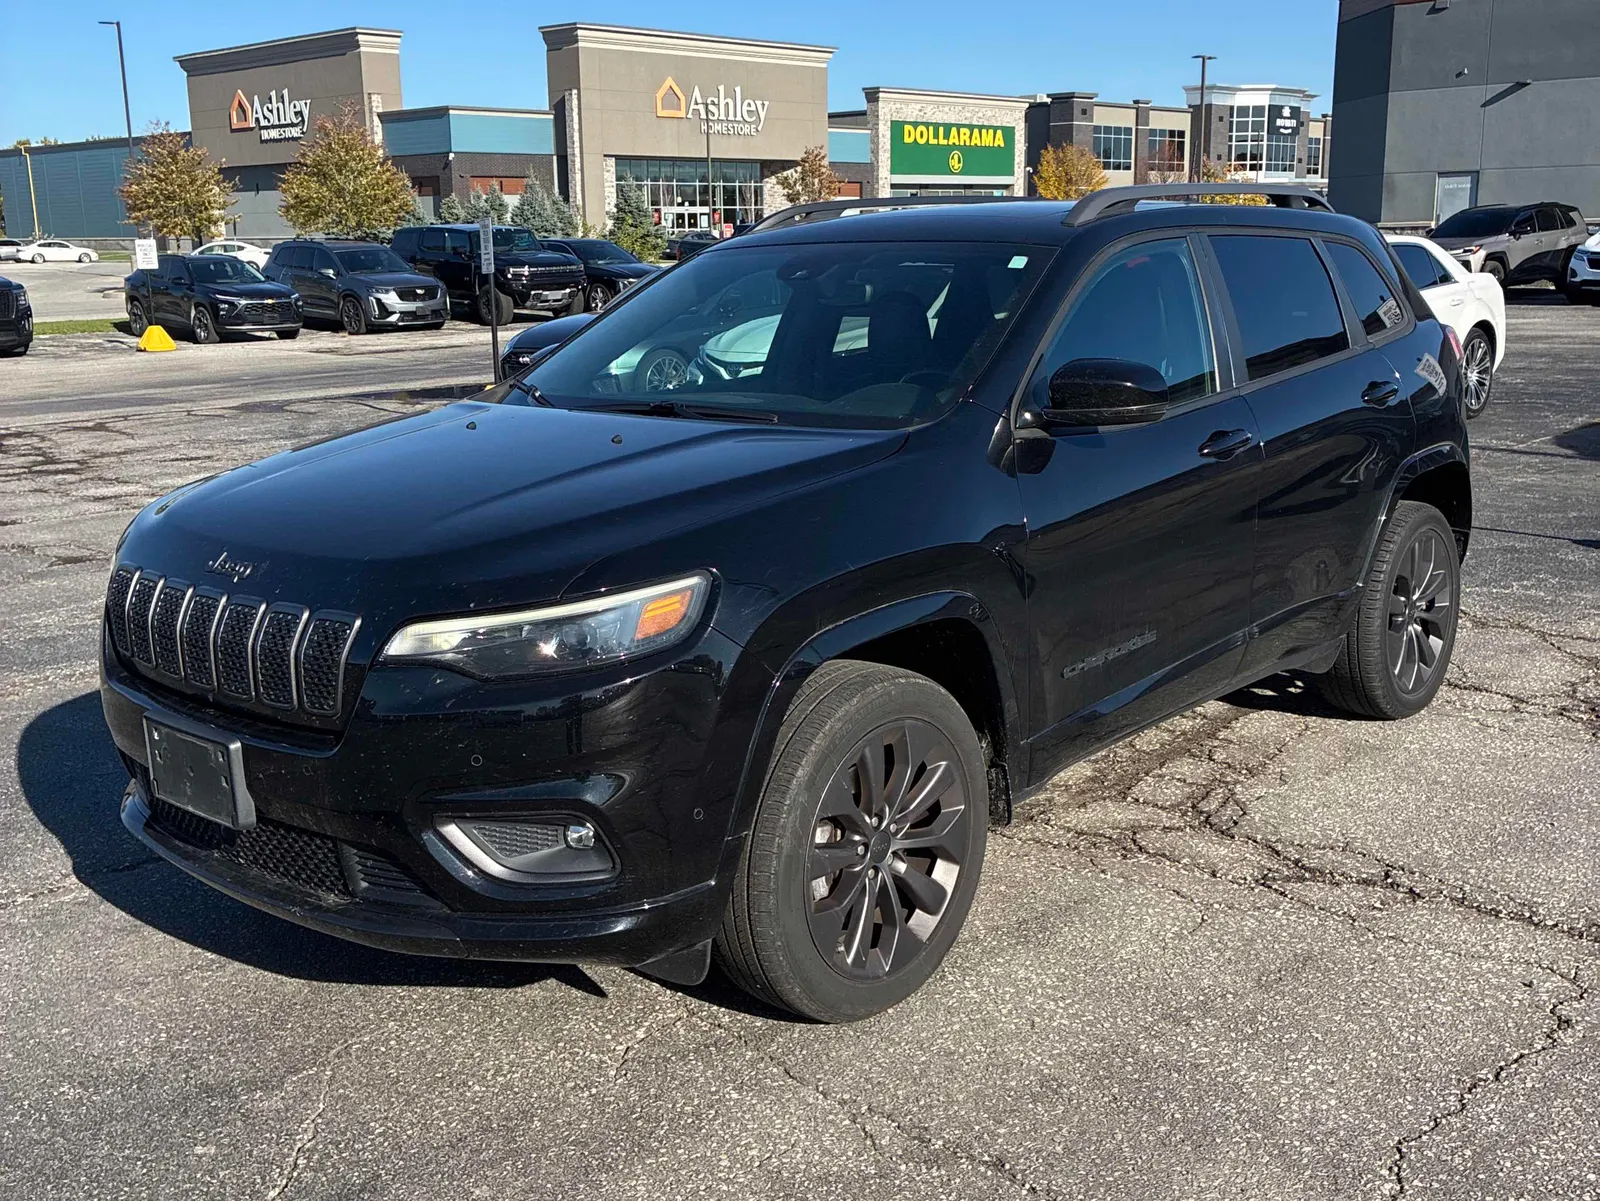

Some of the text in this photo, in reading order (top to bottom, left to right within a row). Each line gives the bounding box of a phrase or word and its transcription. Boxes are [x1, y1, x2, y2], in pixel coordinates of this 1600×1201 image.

[252, 88, 311, 132] Ashley
[686, 84, 769, 131] Ashley
[261, 126, 304, 141] HOMESTORE
[701, 121, 757, 136] HOMESTORE
[903, 124, 1005, 147] DOLLARAMA
[206, 551, 252, 583] Jeep
